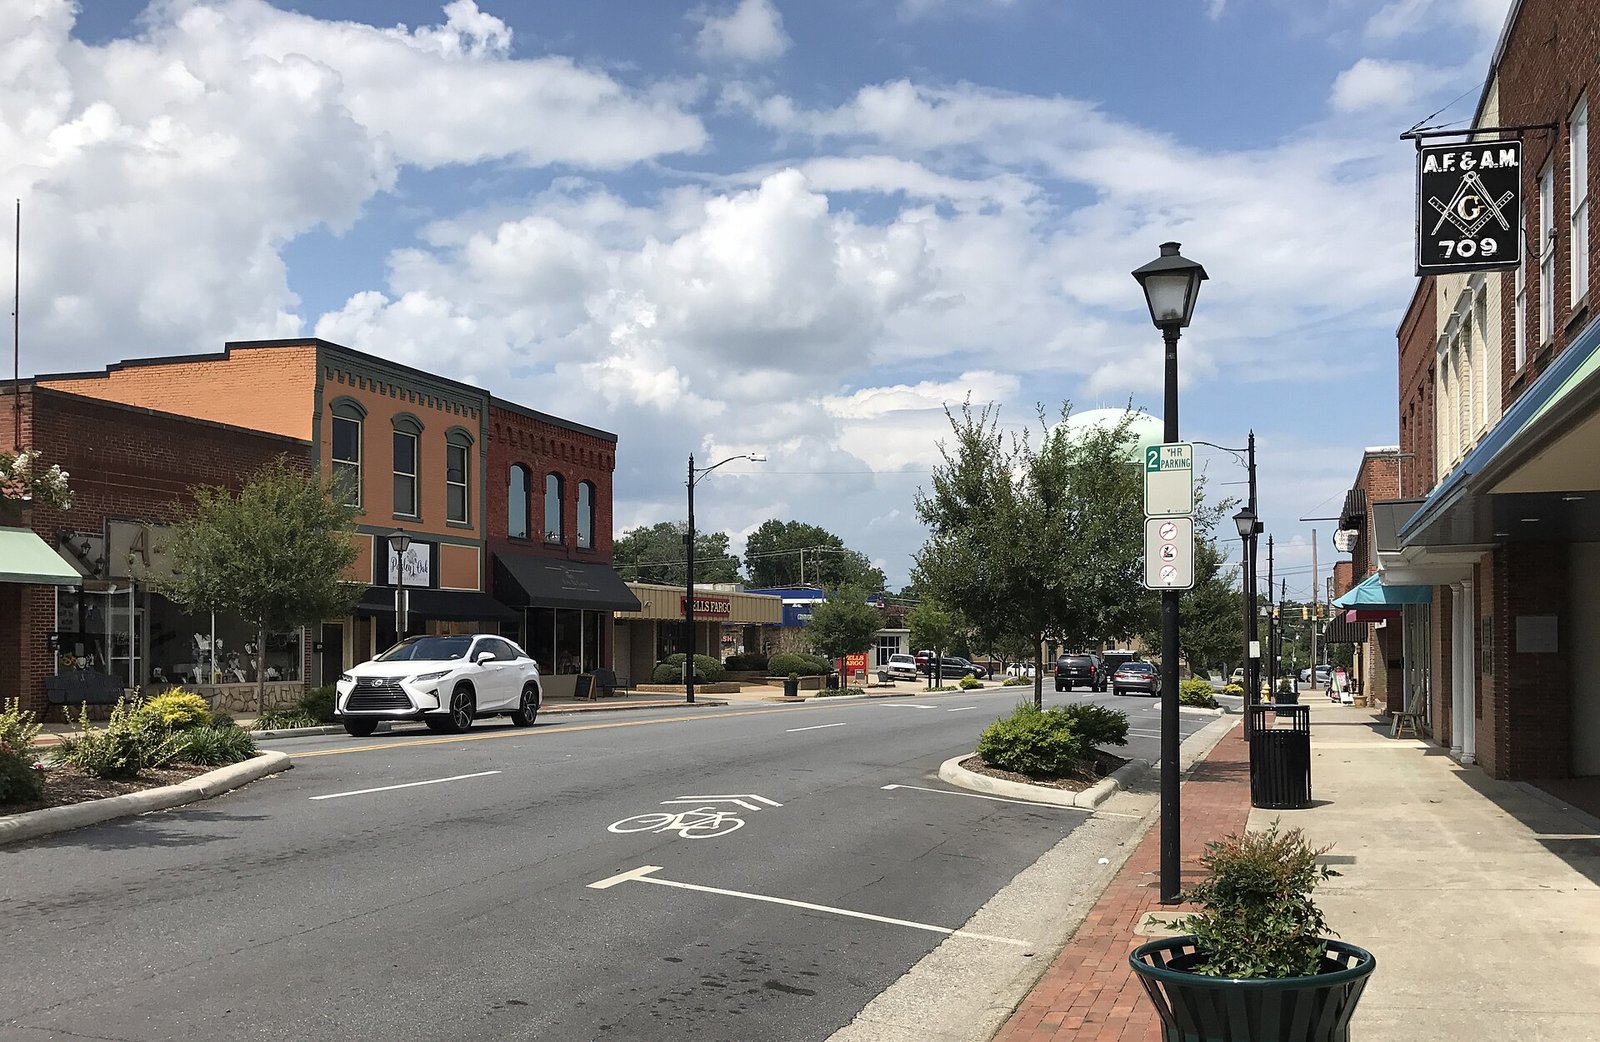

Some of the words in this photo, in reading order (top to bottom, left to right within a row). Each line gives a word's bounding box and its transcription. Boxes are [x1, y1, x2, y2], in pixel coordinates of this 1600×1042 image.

[1423, 152, 1455, 173] A.F.
[1459, 151, 1478, 171] &
[1479, 148, 1519, 169] A.M.
[1457, 194, 1485, 220] G
[1438, 237, 1498, 259] 709
[1147, 450, 1159, 468] 2
[1170, 448, 1183, 457] HR
[1160, 458, 1191, 469] PARKING
[685, 599, 709, 612] ELLS
[710, 601, 732, 614] FARGO
